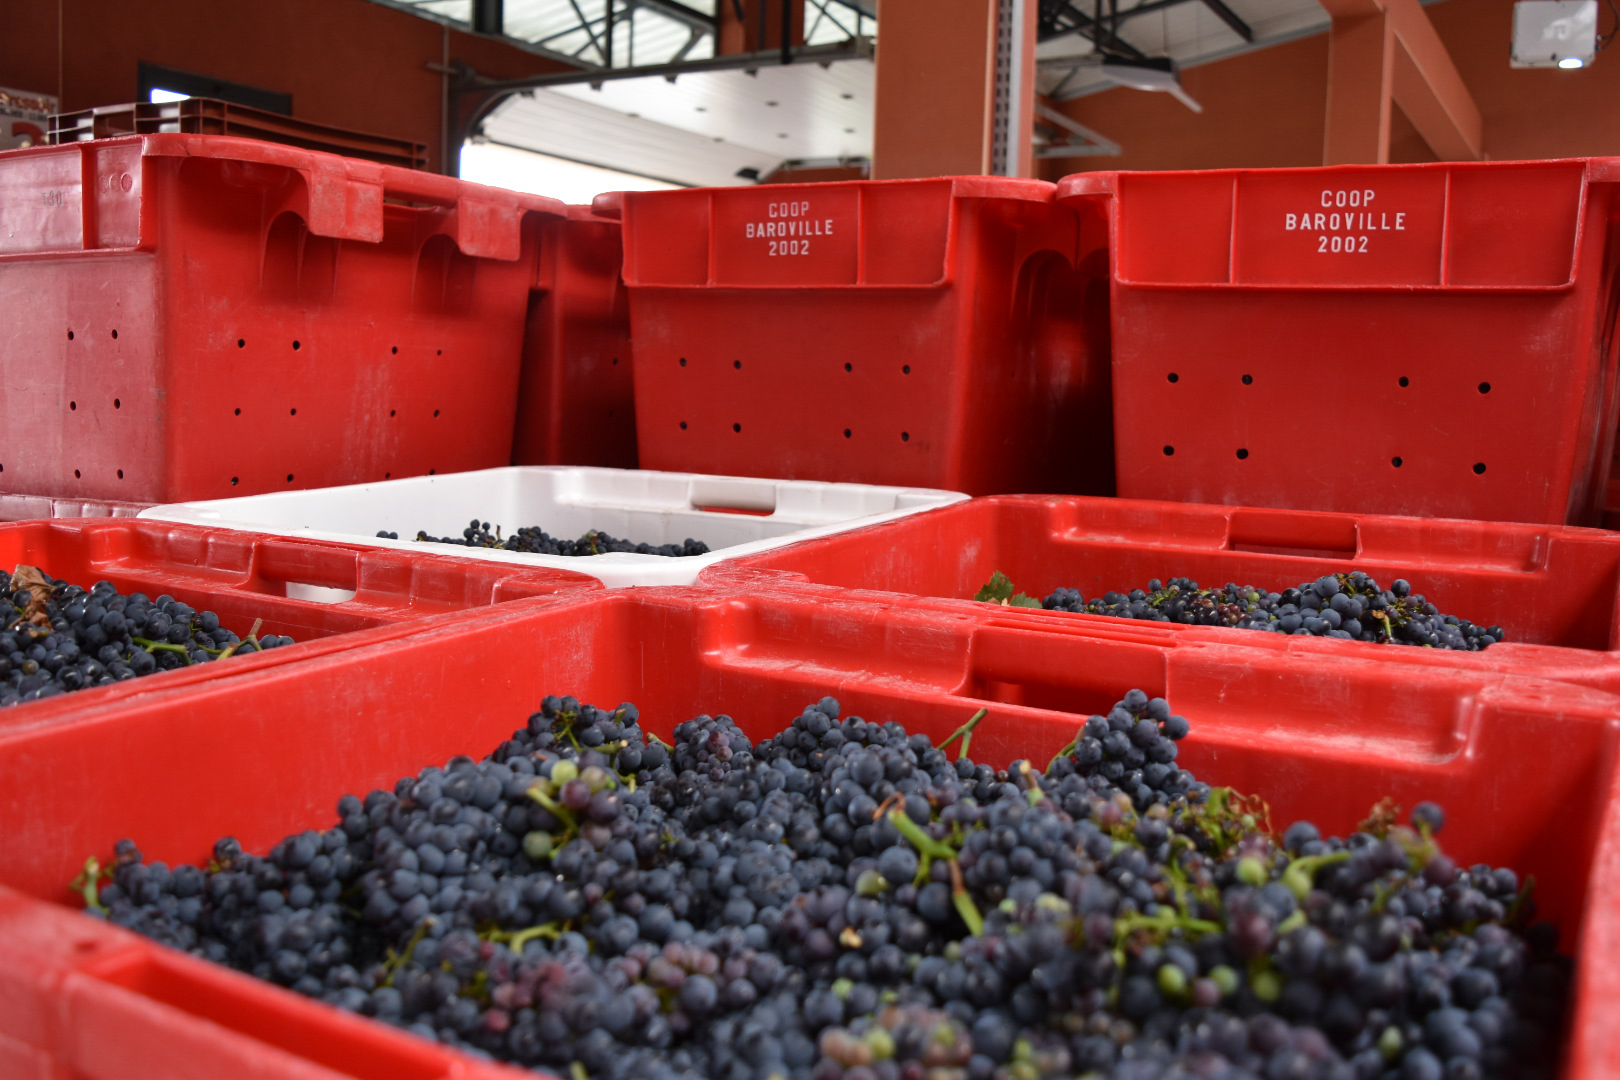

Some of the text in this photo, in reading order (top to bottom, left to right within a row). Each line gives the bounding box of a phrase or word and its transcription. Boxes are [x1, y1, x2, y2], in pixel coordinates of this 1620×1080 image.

[1321, 189, 1375, 207] COOP
[769, 201, 810, 218] COOP
[746, 219, 833, 238] BAROVILLE
[1285, 212, 1406, 230] BAROVILLE
[769, 240, 810, 256] 2002
[1317, 235, 1369, 253] 2002
